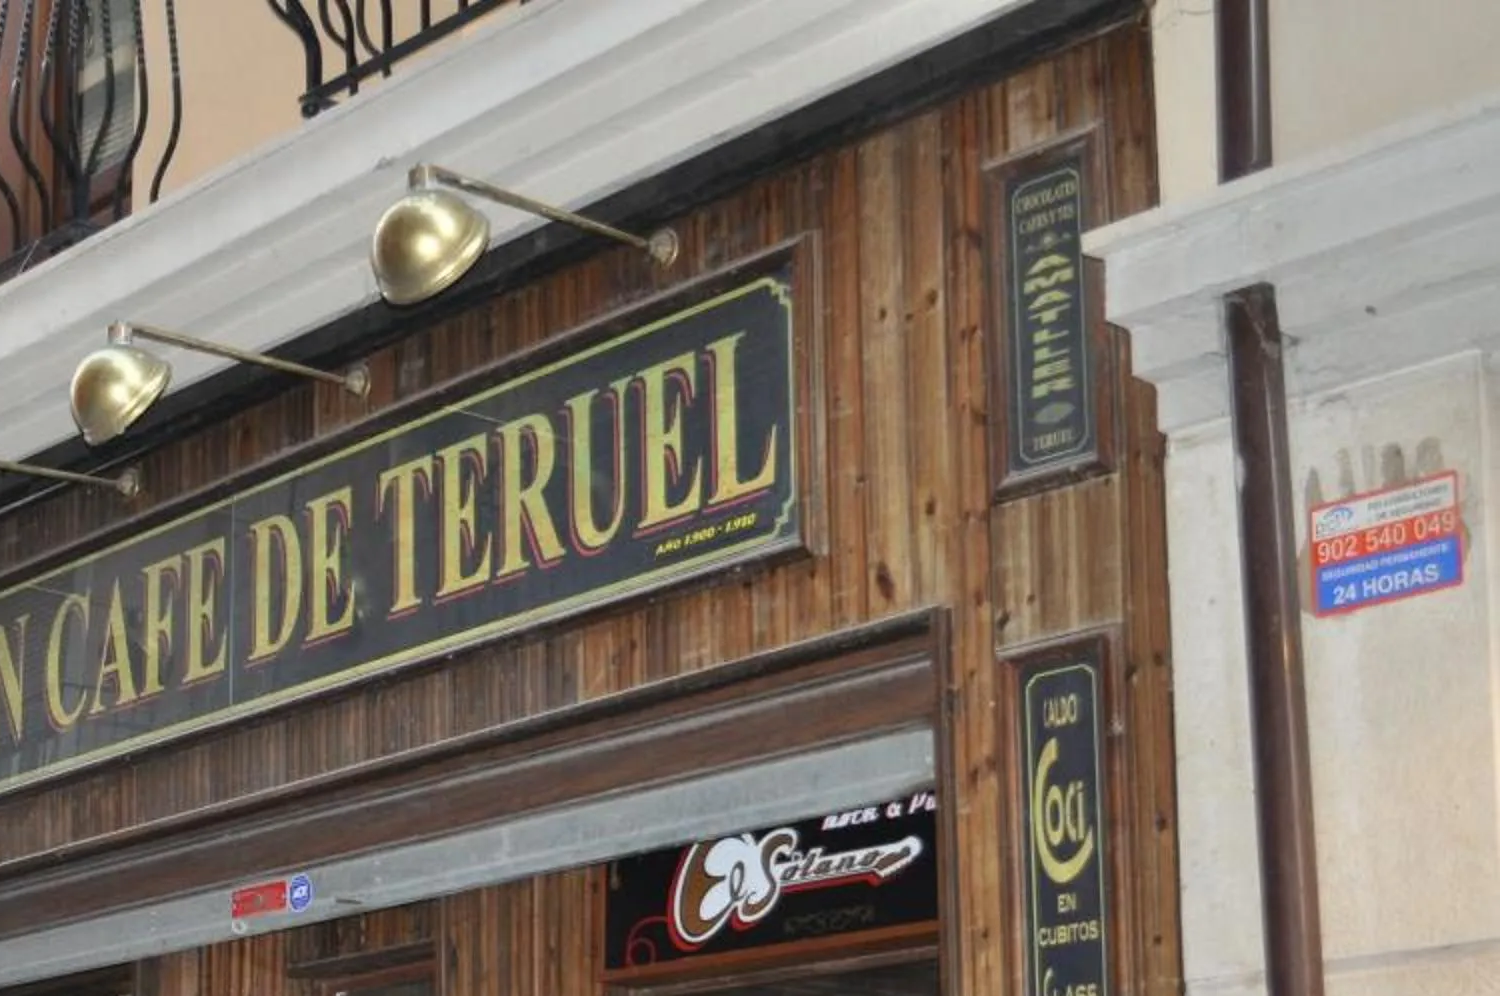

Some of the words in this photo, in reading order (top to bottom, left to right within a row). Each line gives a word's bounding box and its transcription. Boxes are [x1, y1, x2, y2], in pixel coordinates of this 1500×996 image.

[1023, 254, 1075, 399] AMATLLER
[43, 537, 231, 735] CAFE
[247, 486, 358, 662] DE
[378, 330, 780, 620] TERUEL
[1316, 536, 1358, 564] 902
[1364, 523, 1407, 553] 540
[1413, 510, 1456, 541] 049
[1332, 584, 1357, 605] 24
[1361, 563, 1440, 598] HORAS
[1056, 893, 1077, 913] EN
[1038, 920, 1099, 946] CUBITOS
